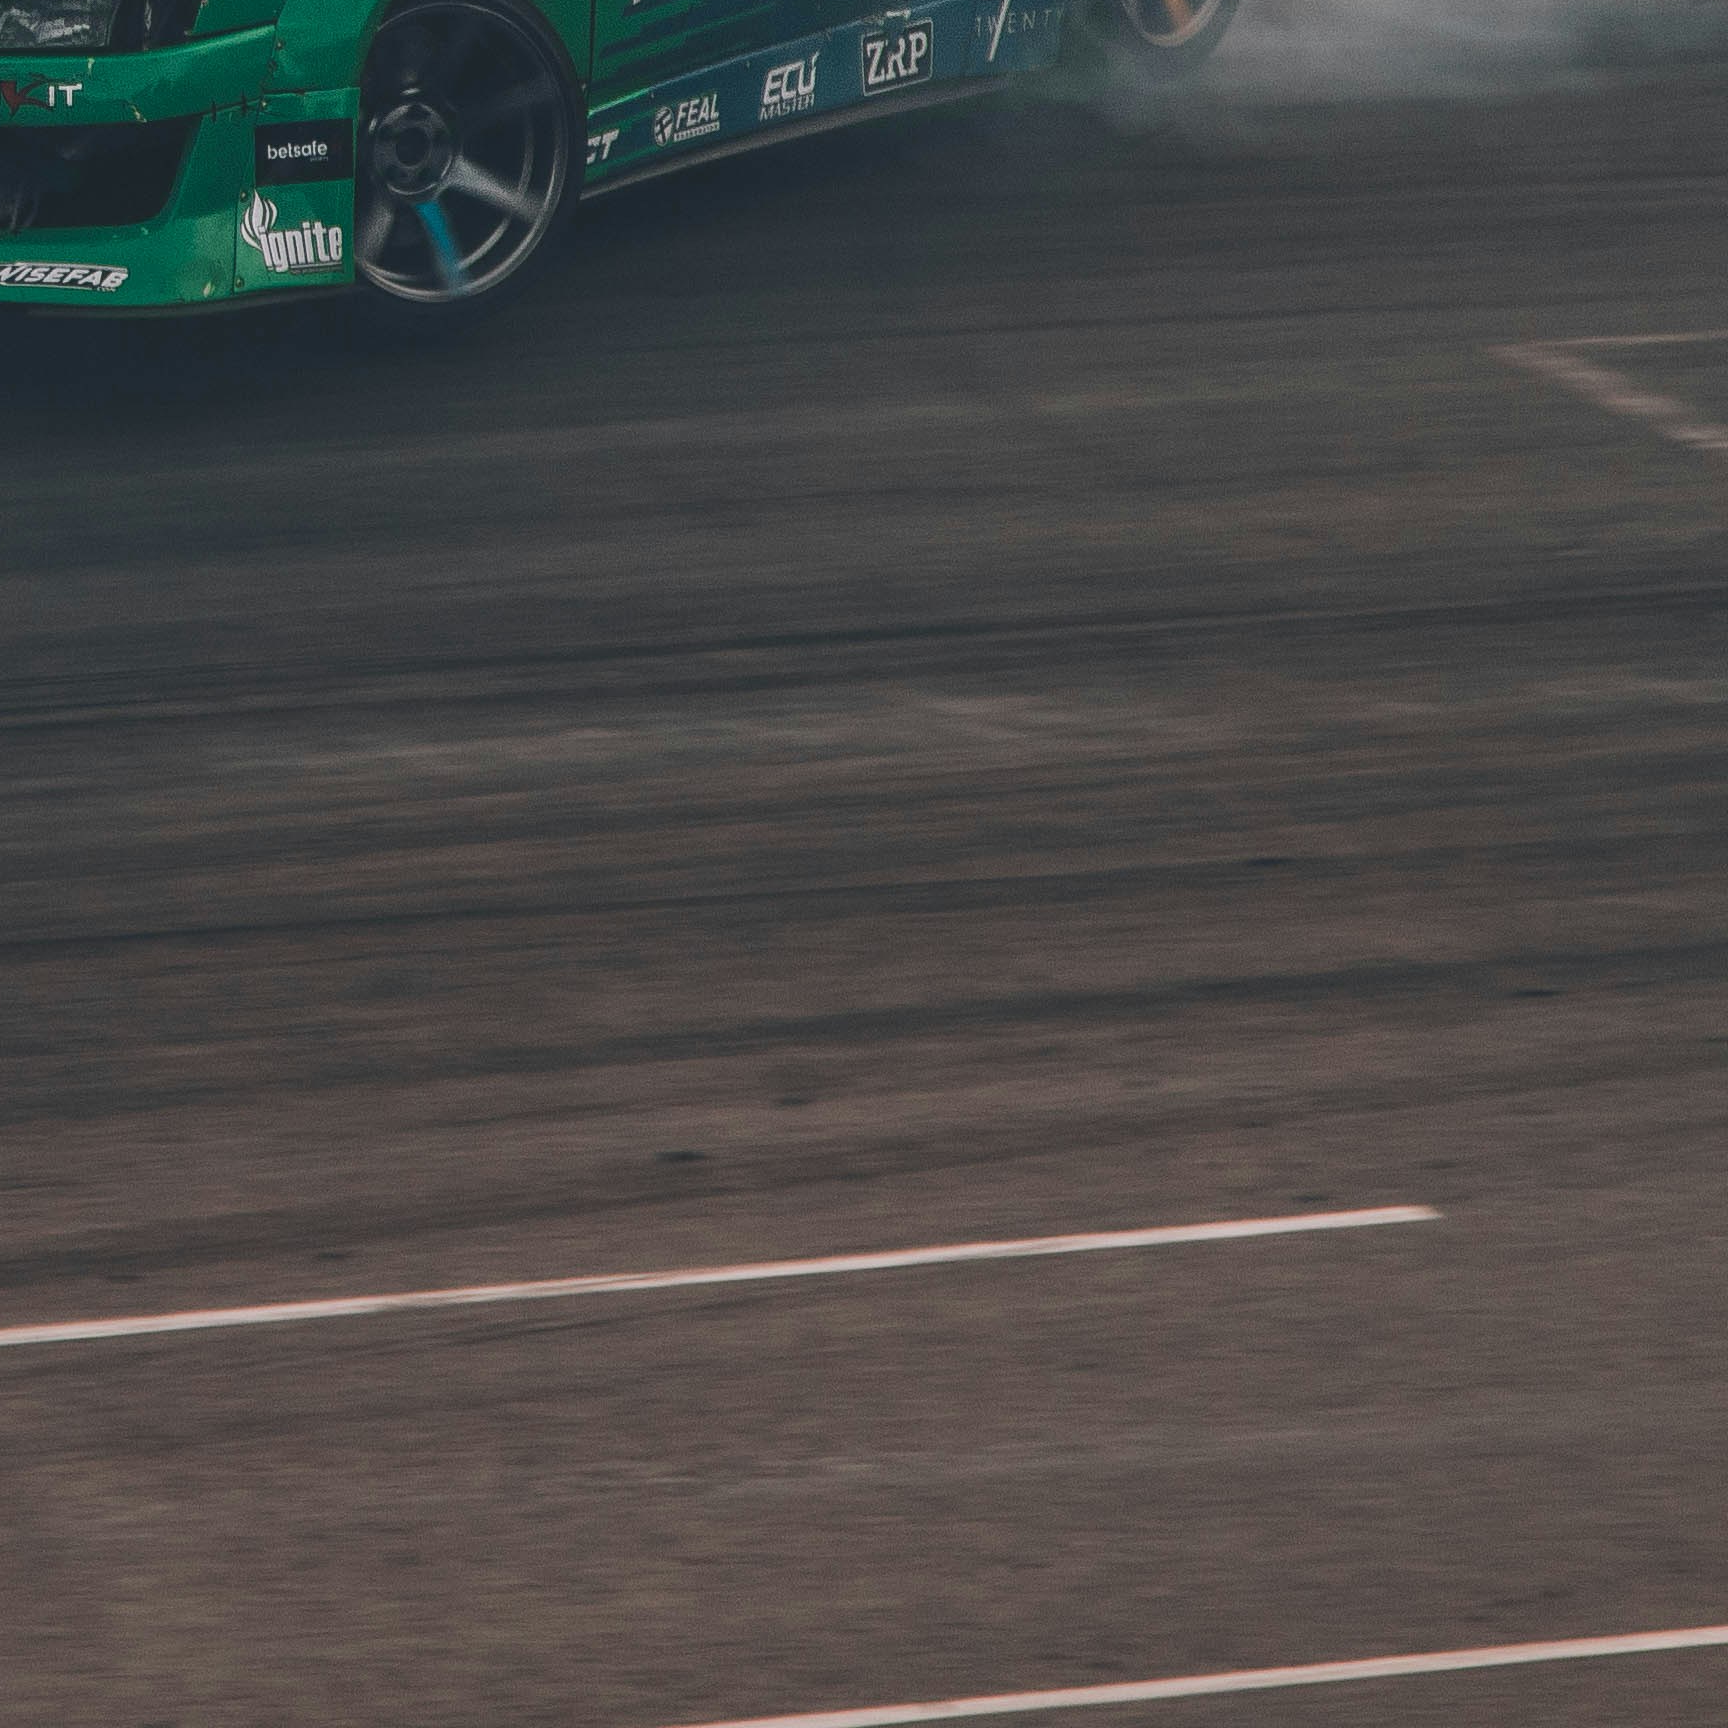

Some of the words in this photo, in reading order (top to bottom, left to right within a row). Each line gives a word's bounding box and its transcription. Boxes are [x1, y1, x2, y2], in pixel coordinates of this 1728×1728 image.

[763, 52, 820, 105] ECU
[866, 30, 928, 86] ZRP
[675, 93, 720, 129] FEAL
[267, 140, 328, 160] betsafe
[259, 221, 343, 273] ignite
